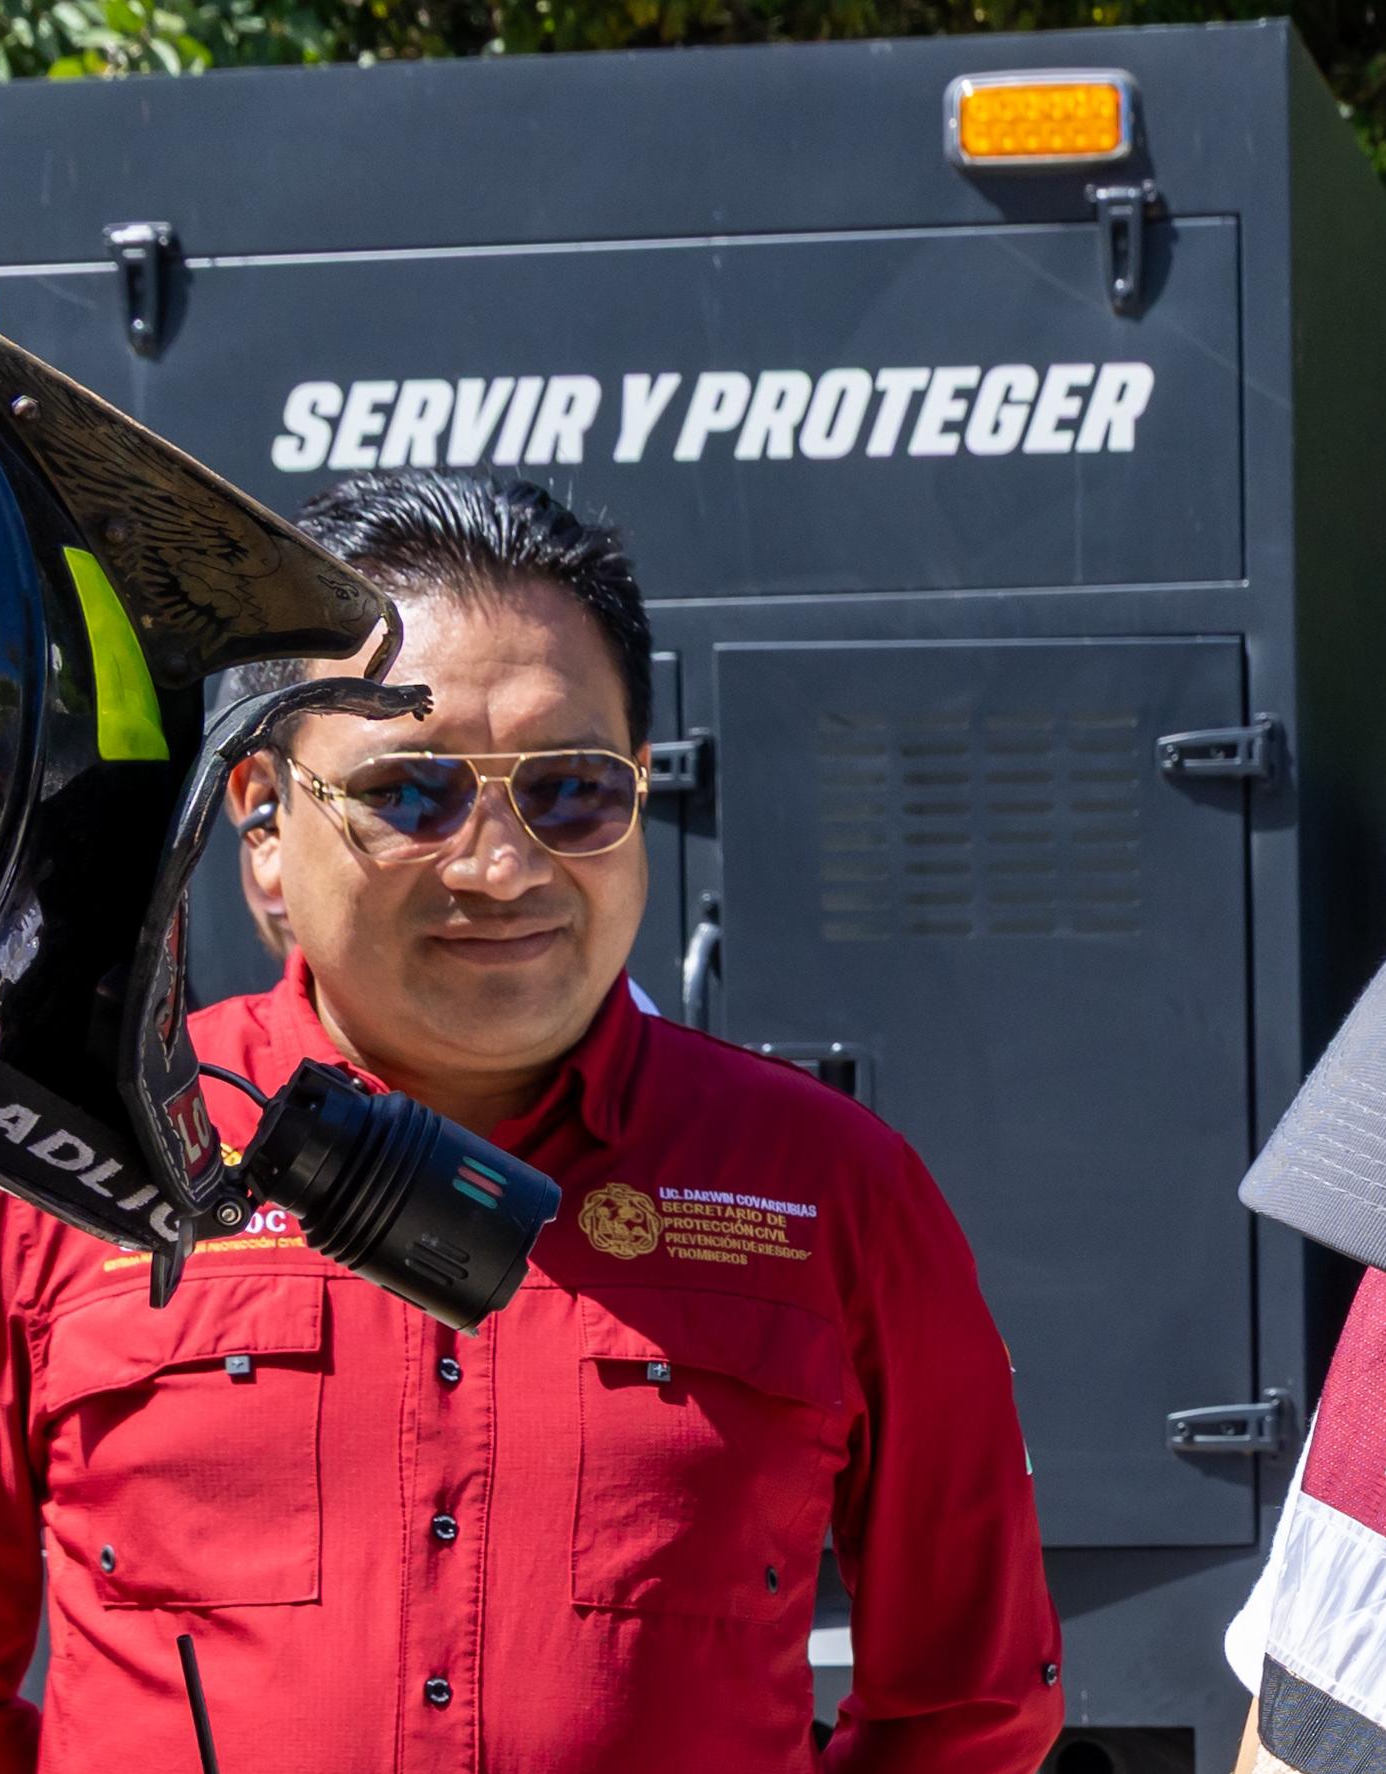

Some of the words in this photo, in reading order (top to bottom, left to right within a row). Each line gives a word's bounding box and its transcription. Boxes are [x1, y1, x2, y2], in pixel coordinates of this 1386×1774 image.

[271, 374, 602, 472] SERVIR
[613, 373, 682, 463] Y
[673, 361, 1155, 462] PROTEGER
[662, 1201, 762, 1222] SECRETARIO
[766, 1213, 787, 1227] DE
[684, 1189, 734, 1204] DARWIN
[736, 1194, 817, 1218] COVARRUBIAS
[664, 1217, 754, 1238] PROTECCIÓN
[755, 1226, 789, 1244] CIVIL
[665, 1232, 741, 1250] PREVENCIÓN
[667, 1246, 678, 1258] Y
[677, 1247, 748, 1265] BOMBEROS
